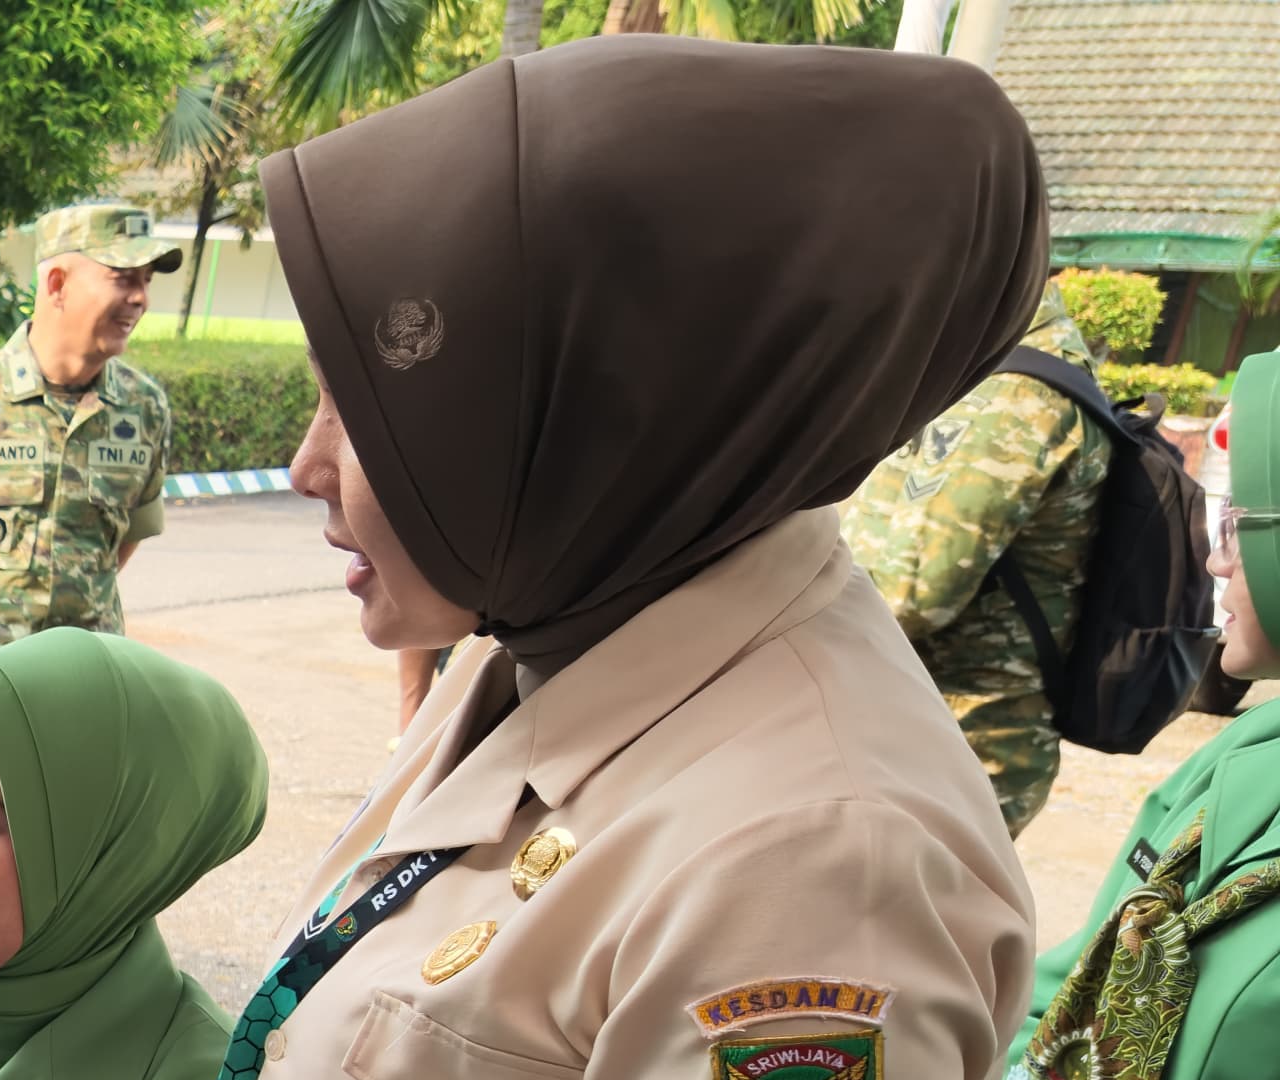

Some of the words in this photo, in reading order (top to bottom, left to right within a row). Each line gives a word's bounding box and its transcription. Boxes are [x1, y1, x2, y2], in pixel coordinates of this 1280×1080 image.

[97, 447, 123, 463] TNI
[129, 449, 147, 465] AD
[370, 882, 398, 912] RS
[746, 1048, 847, 1076] SRIWIJAYA
